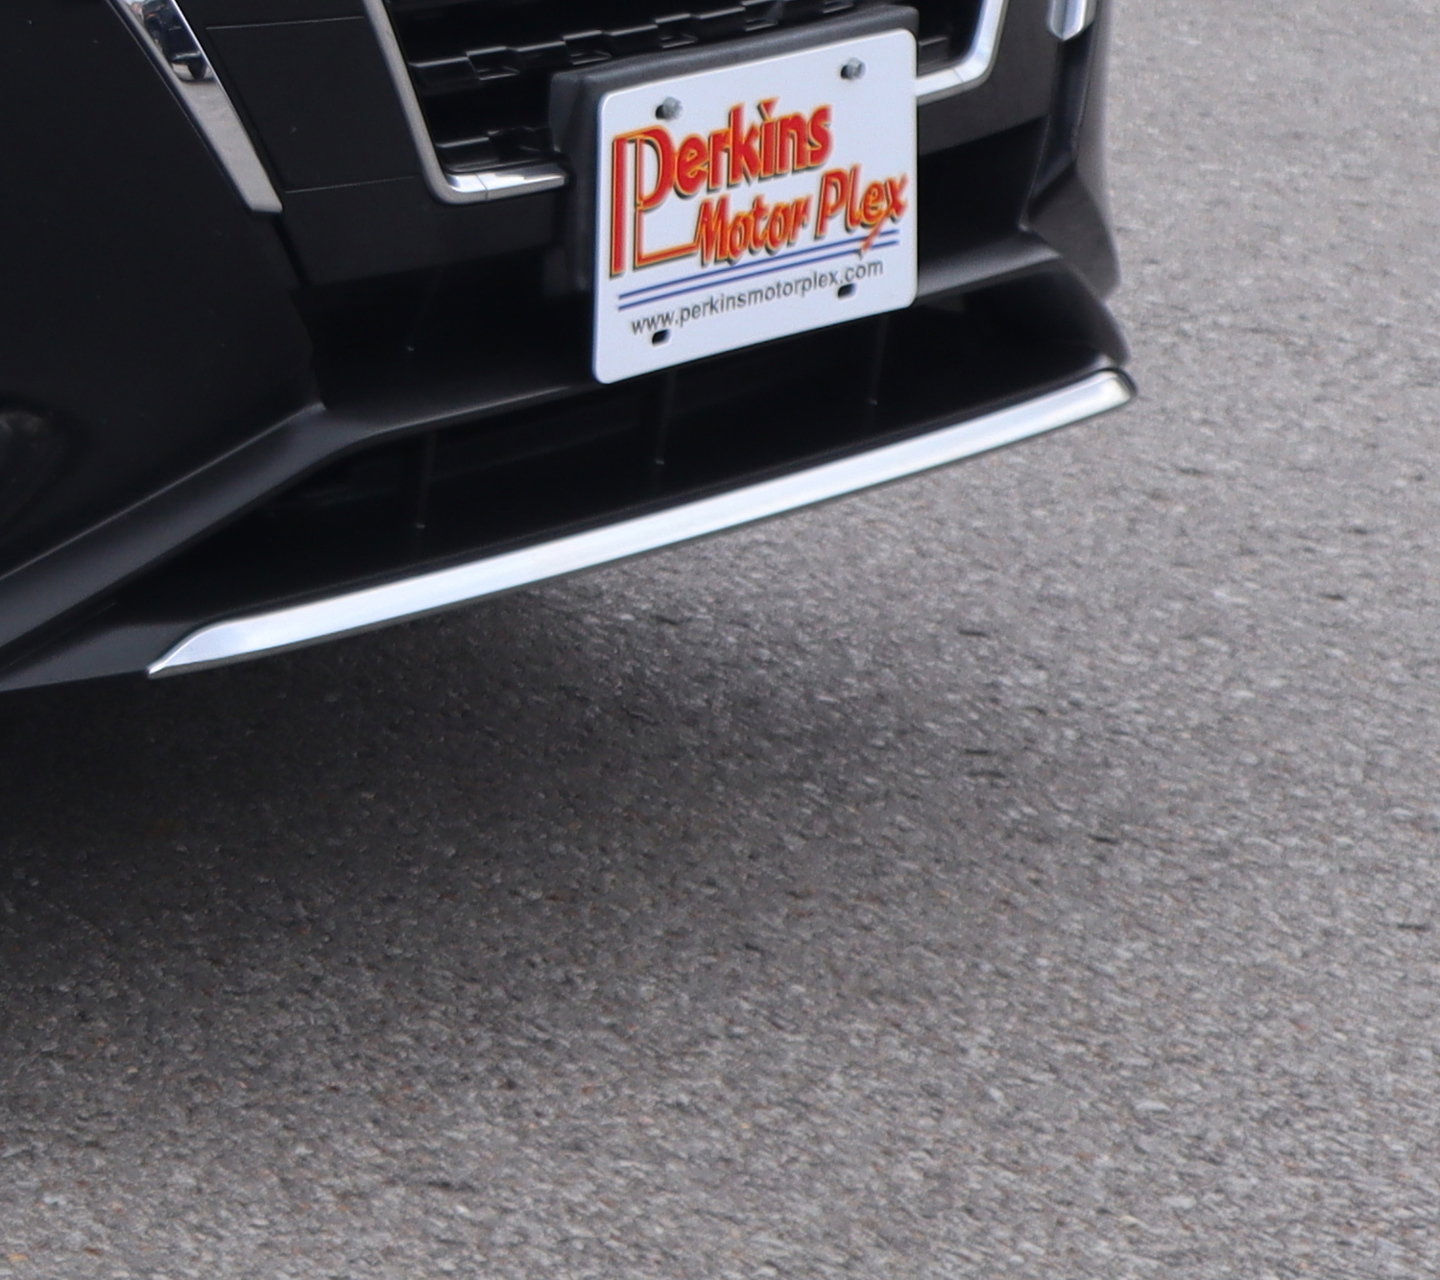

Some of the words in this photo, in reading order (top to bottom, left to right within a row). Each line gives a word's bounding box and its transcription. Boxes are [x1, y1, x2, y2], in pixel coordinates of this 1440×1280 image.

[610, 96, 833, 280] Perkins
[696, 192, 813, 268] Motor
[815, 164, 910, 254] Plex
[631, 257, 885, 335] www.perkinsmotorplex.com
